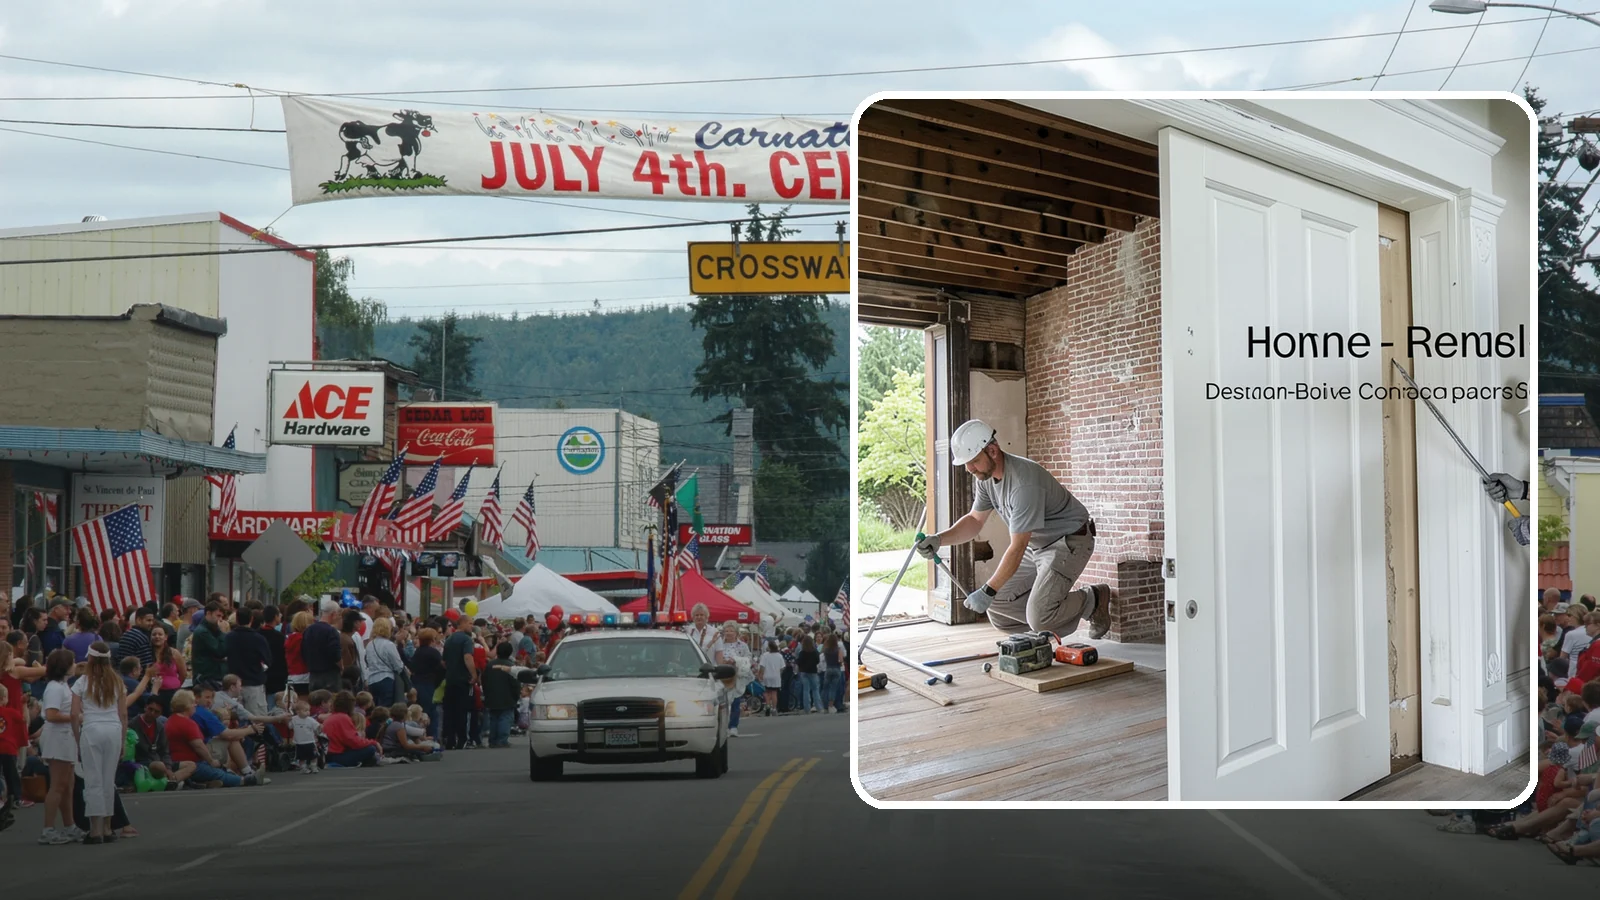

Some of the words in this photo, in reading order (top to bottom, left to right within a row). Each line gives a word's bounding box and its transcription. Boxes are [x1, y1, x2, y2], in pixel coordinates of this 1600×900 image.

[695, 121, 850, 150] Carnat
[481, 141, 605, 193] JULY
[632, 150, 746, 198] 4th.
[697, 254, 850, 280] CROSSWA
[283, 380, 373, 420] ACE
[405, 409, 453, 422] CEDAR
[461, 409, 485, 422] LOG
[283, 421, 371, 436] Hardware
[416, 428, 477, 447] Coca-Cola
[96, 485, 125, 494] Vincent
[126, 486, 136, 495] de
[138, 486, 155, 495] Paul
[688, 526, 741, 535] CRNATION
[699, 535, 730, 543] GLASS
